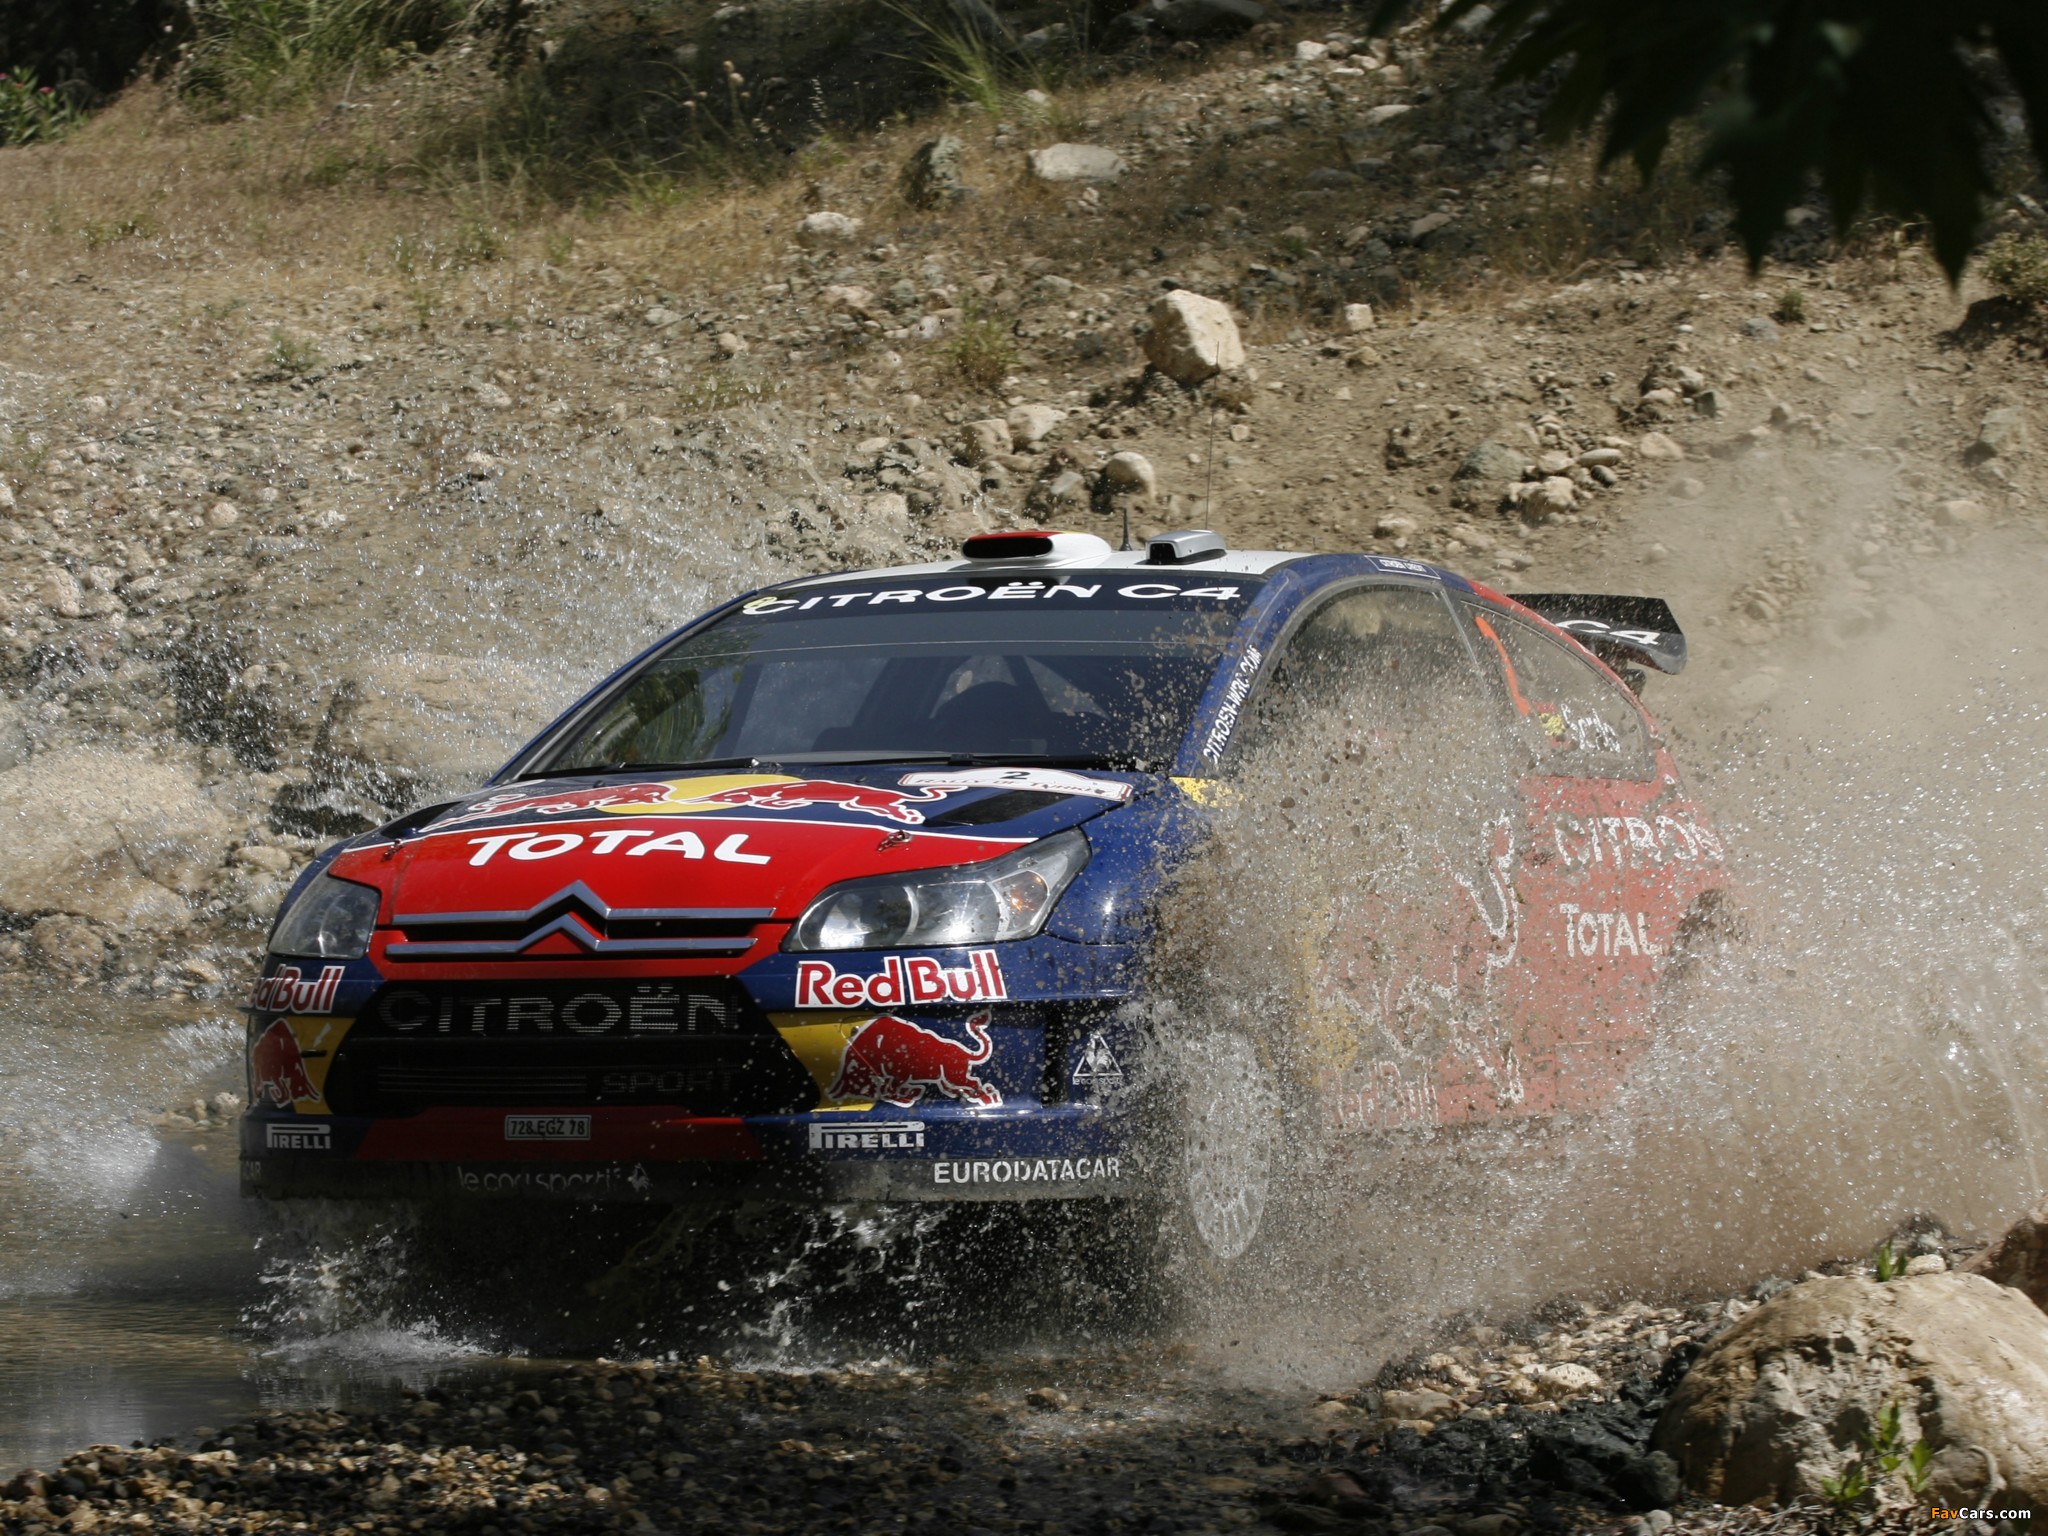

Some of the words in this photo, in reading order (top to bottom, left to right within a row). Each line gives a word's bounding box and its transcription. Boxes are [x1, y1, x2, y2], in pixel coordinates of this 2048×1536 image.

[742, 581, 1103, 615] CITROËN
[1117, 583, 1241, 601] C4
[1555, 620, 1660, 645] C4
[999, 771, 1030, 780] 2
[468, 830, 771, 867] TOTAL
[1560, 903, 1664, 958] TOTAL
[269, 965, 346, 1013] Bull
[795, 956, 905, 1008] Red
[904, 949, 1007, 1004] Bull
[378, 985, 738, 1034] CITROËN
[266, 1123, 332, 1150] PIRELLI
[510, 1120, 533, 1136] 728
[537, 1120, 565, 1136] EGZ
[569, 1119, 585, 1136] 78
[809, 1121, 925, 1149] PIRELLI
[934, 1157, 1121, 1184] EURODATACAR
